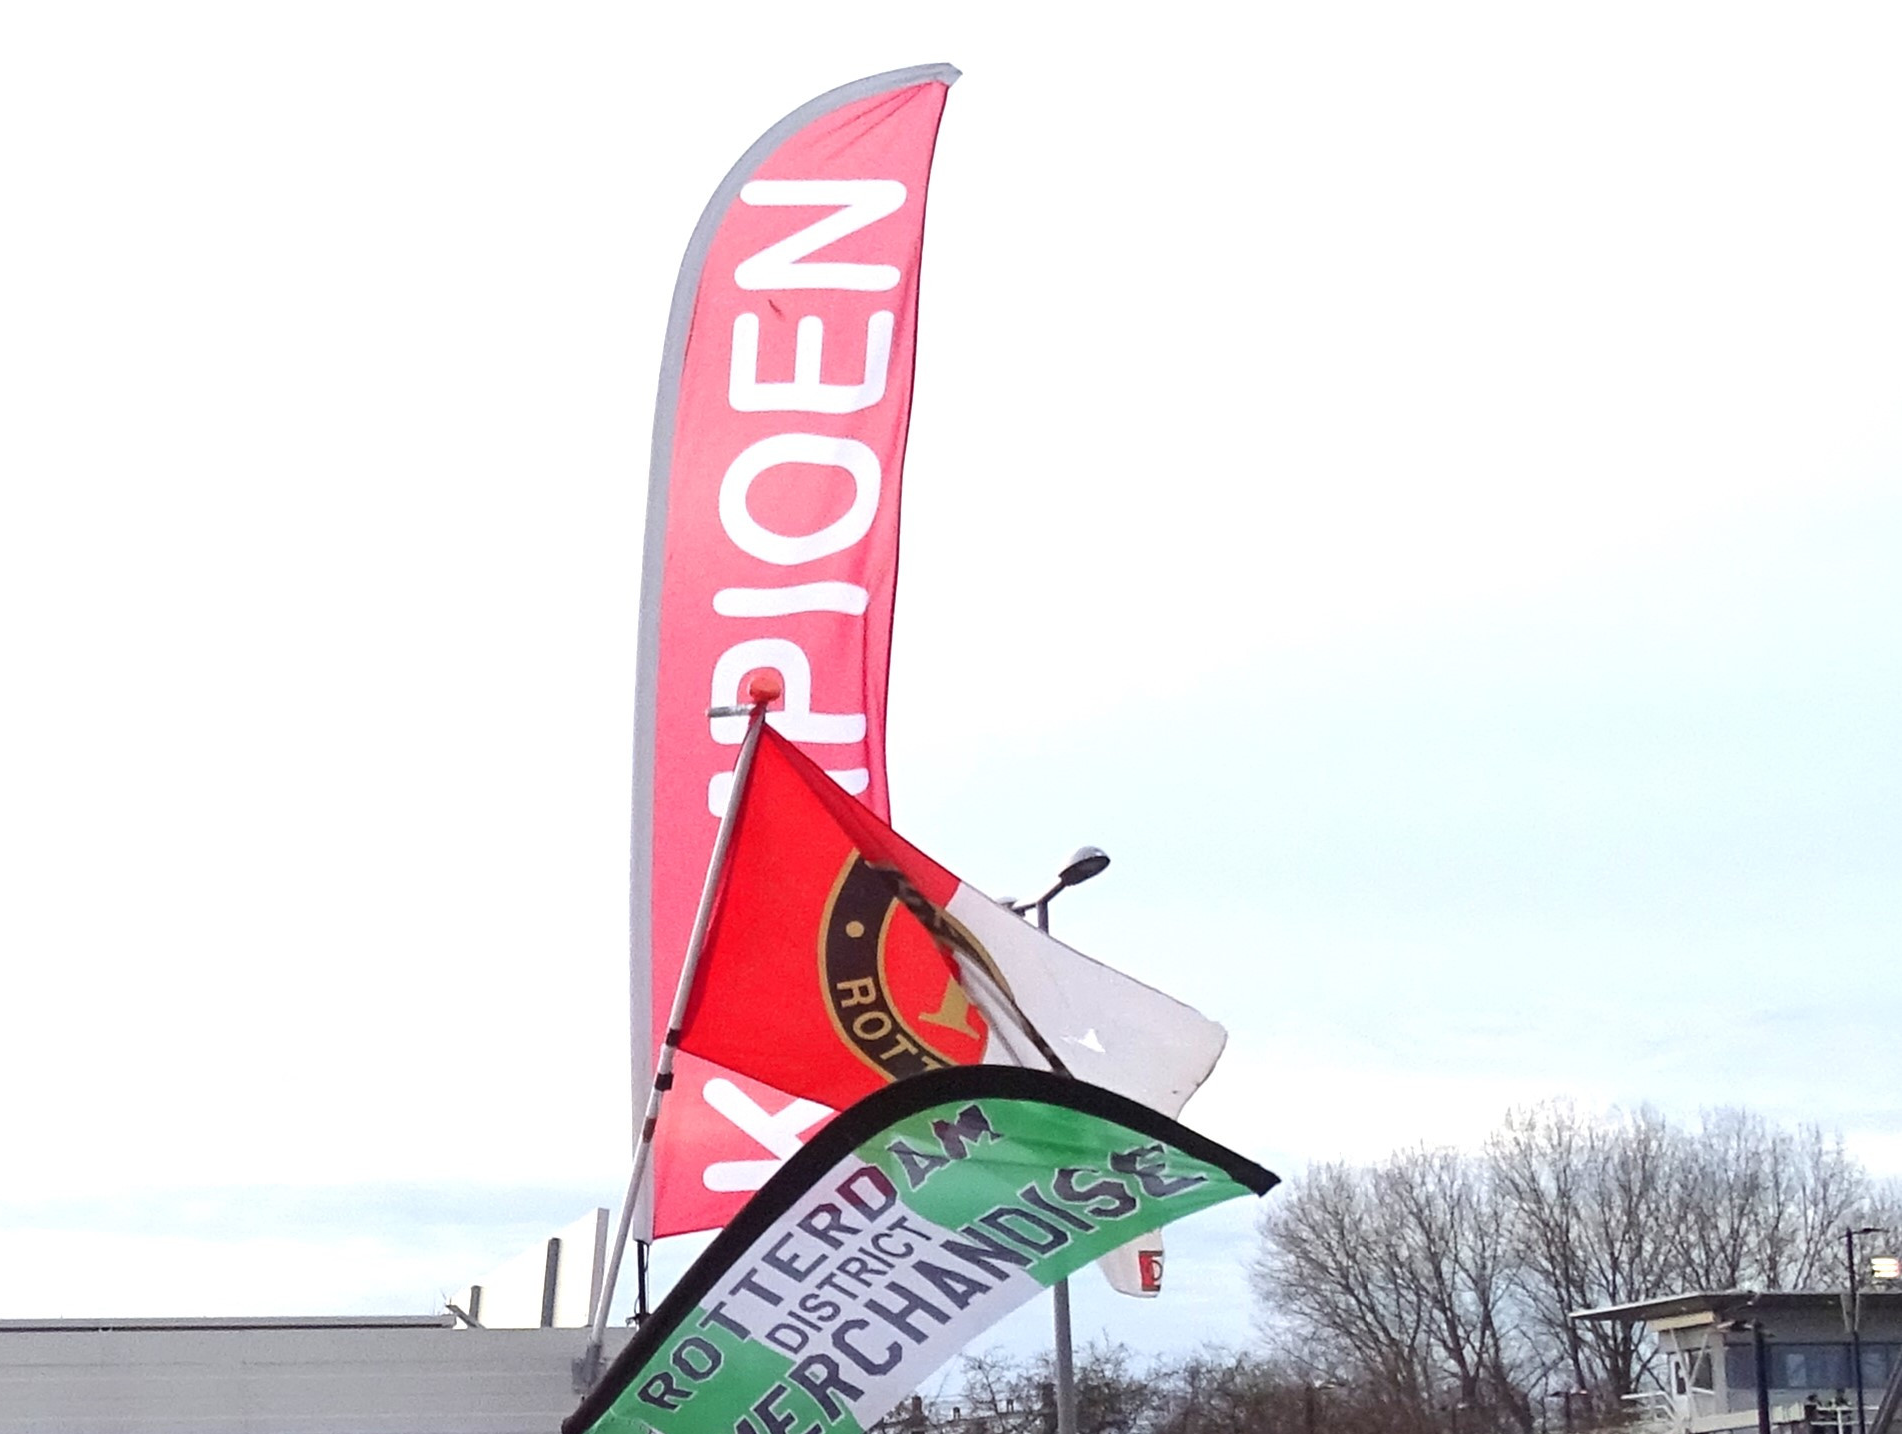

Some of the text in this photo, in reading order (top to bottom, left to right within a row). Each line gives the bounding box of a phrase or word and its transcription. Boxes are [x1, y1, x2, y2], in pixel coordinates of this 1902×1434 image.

[702, 178, 909, 1195] KPIOEN
[638, 1103, 1004, 1415] ROTTERDAM
[765, 1215, 936, 1358] DISTRICT
